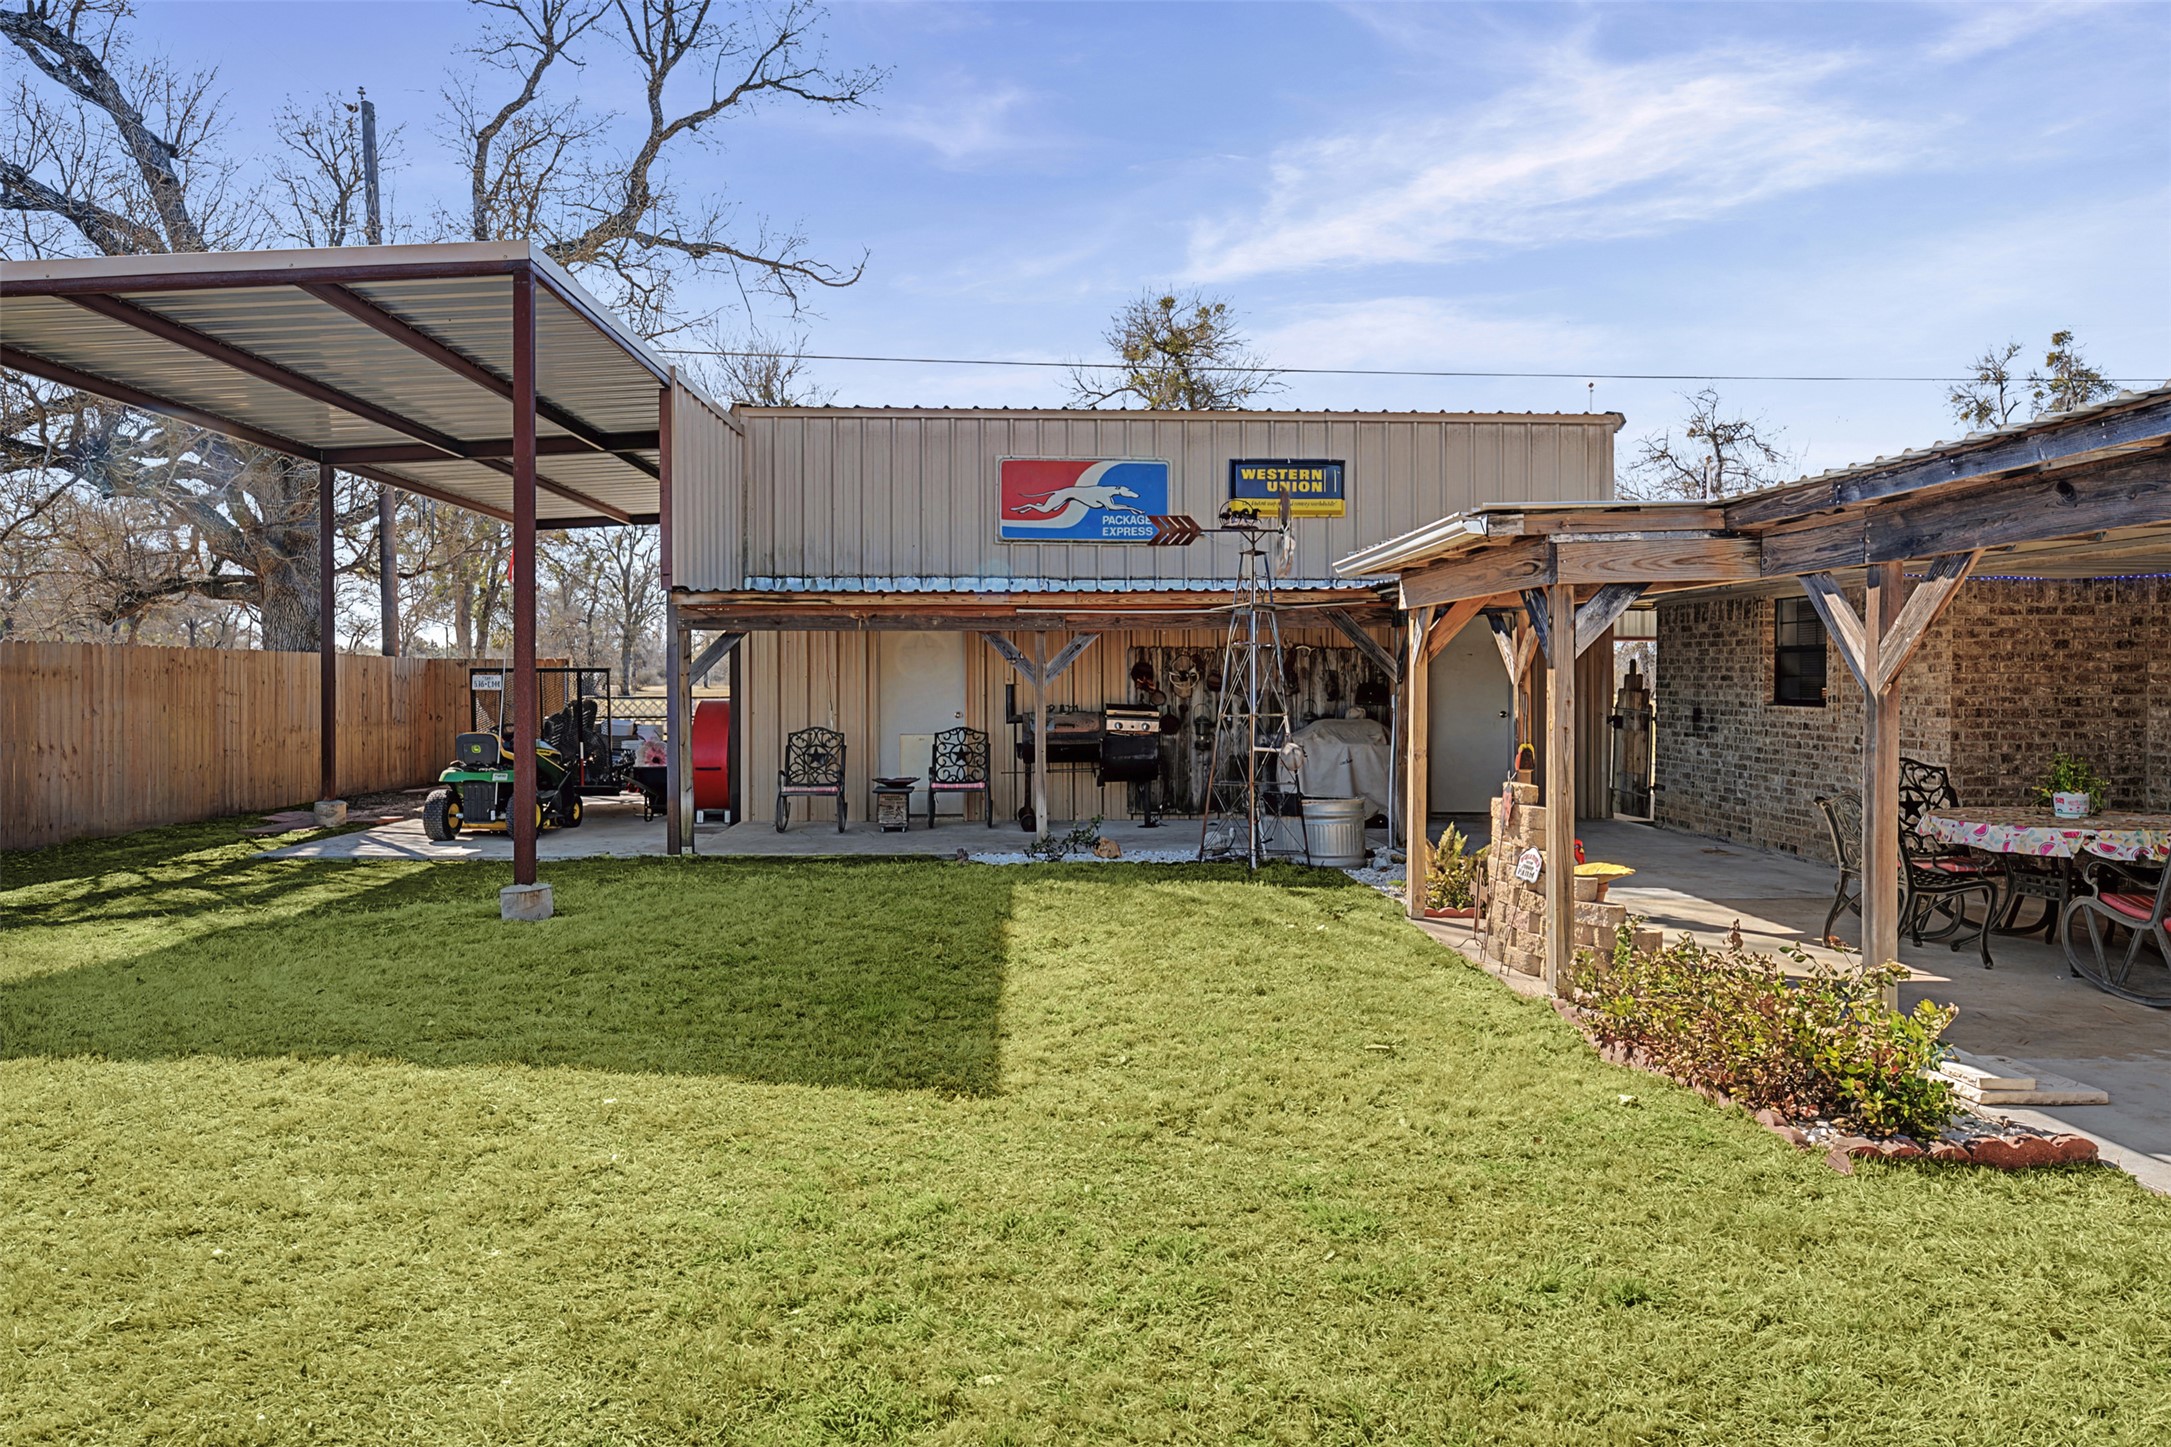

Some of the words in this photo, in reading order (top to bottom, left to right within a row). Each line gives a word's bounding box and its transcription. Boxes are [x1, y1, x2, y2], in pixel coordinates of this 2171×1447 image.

[1241, 468, 1322, 480] WESTERN
[1266, 481, 1322, 492] UNION
[1102, 515, 1152, 525] PACKAGE
[1102, 526, 1153, 536] EXPRESS
